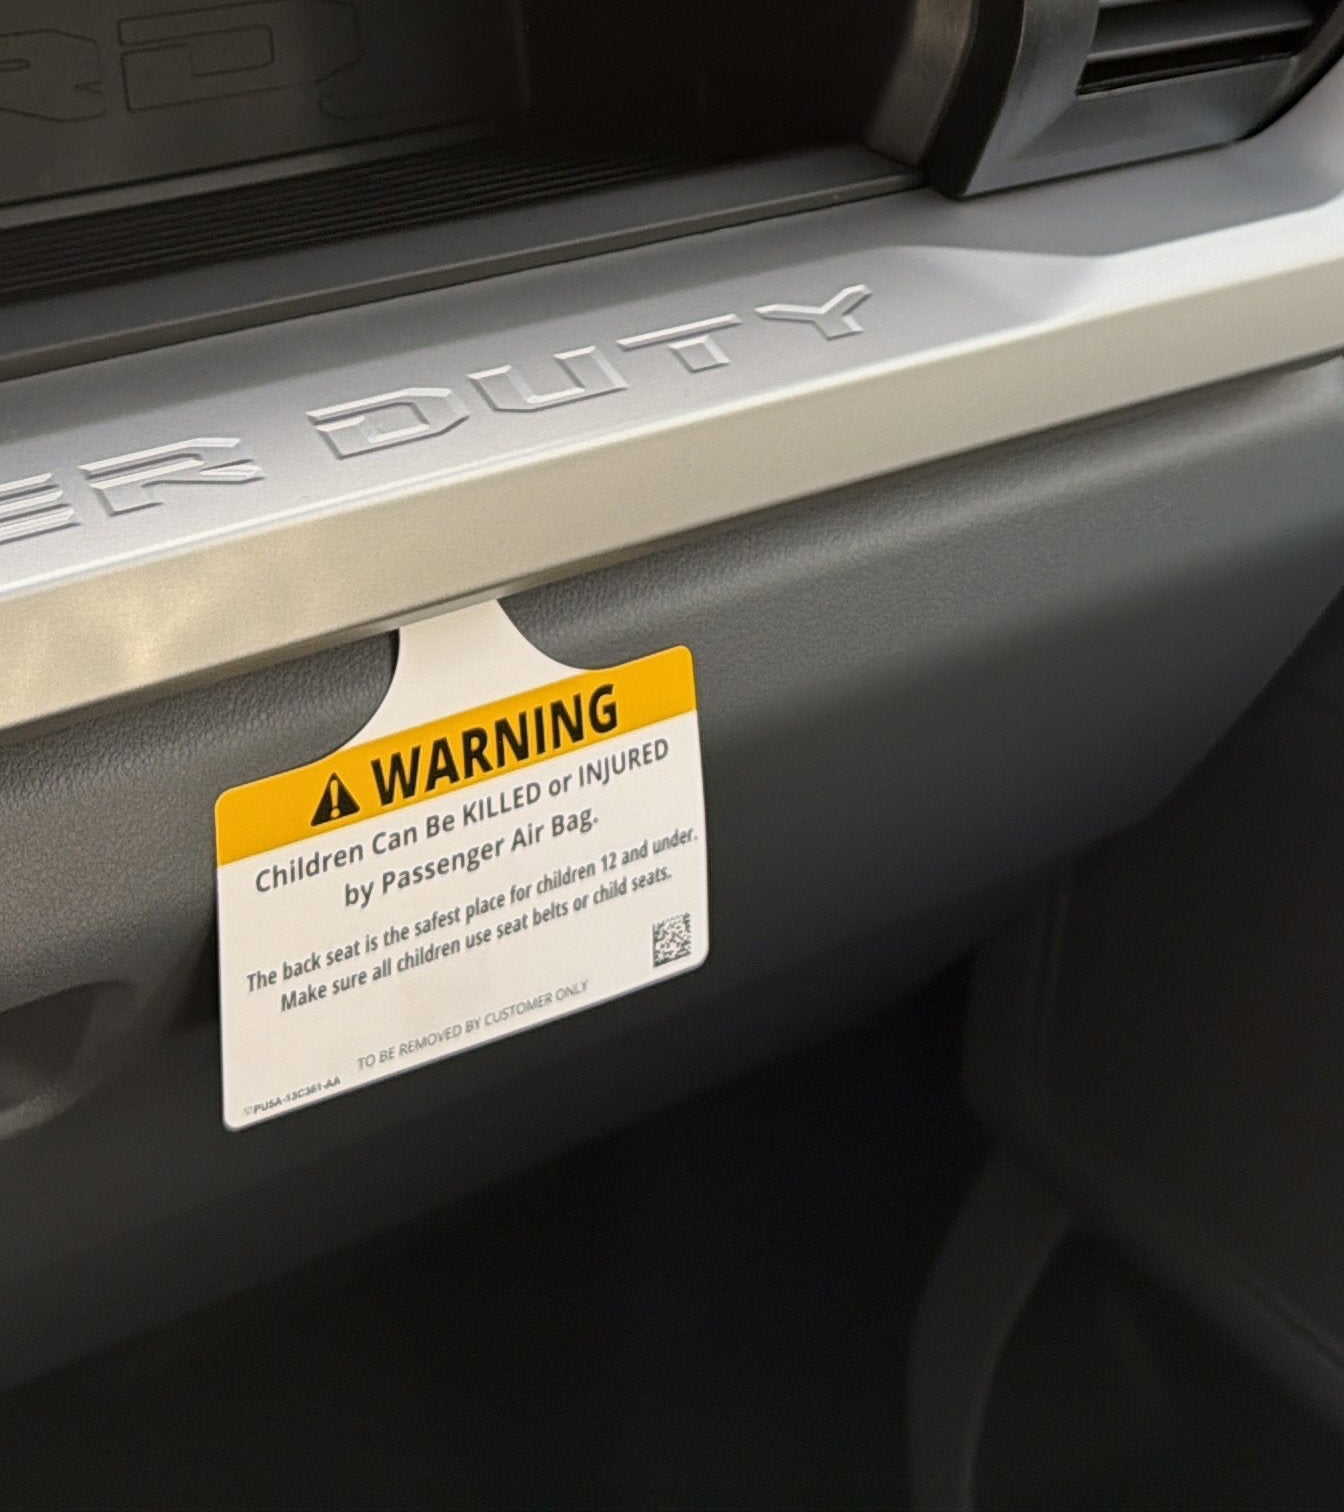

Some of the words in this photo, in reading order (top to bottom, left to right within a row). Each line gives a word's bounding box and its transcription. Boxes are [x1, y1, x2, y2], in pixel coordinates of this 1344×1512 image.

[306, 284, 873, 460] DUTY
[256, 843, 364, 893] Children
[372, 825, 418, 855] Can
[426, 813, 455, 839] Be
[462, 781, 541, 827] KILLED
[548, 774, 573, 797] or
[578, 737, 669, 787] INJURED
[370, 683, 618, 807] WARNING
[246, 969, 278, 993] The
[282, 951, 322, 981] back
[326, 940, 361, 966] seat
[365, 934, 378, 953] is
[383, 925, 409, 947] the
[414, 906, 461, 937] safest
[465, 893, 506, 925] place
[510, 883, 532, 904] for
[537, 862, 596, 895] children
[600, 851, 617, 872] 12
[621, 839, 648, 865] and
[652, 827, 699, 855] under.
[344, 881, 375, 909] by
[382, 837, 506, 895] Passenger
[511, 822, 545, 852] Air
[551, 807, 599, 838] Bag.
[281, 984, 328, 1012] Make
[332, 970, 367, 995] sure
[372, 957, 392, 981] all
[397, 938, 461, 973] children
[465, 927, 492, 950] use
[496, 914, 529, 939] seat
[532, 901, 569, 927] belts
[573, 894, 589, 911] or
[593, 876, 627, 905] child
[631, 865, 673, 892] seats.
[357, 1053, 377, 1070] TO
[379, 1046, 396, 1064] BE
[398, 1023, 463, 1056] REMOVED
[465, 1017, 483, 1034] BY
[484, 992, 554, 1027] CUSTOMER
[555, 980, 590, 1002] ONLY
